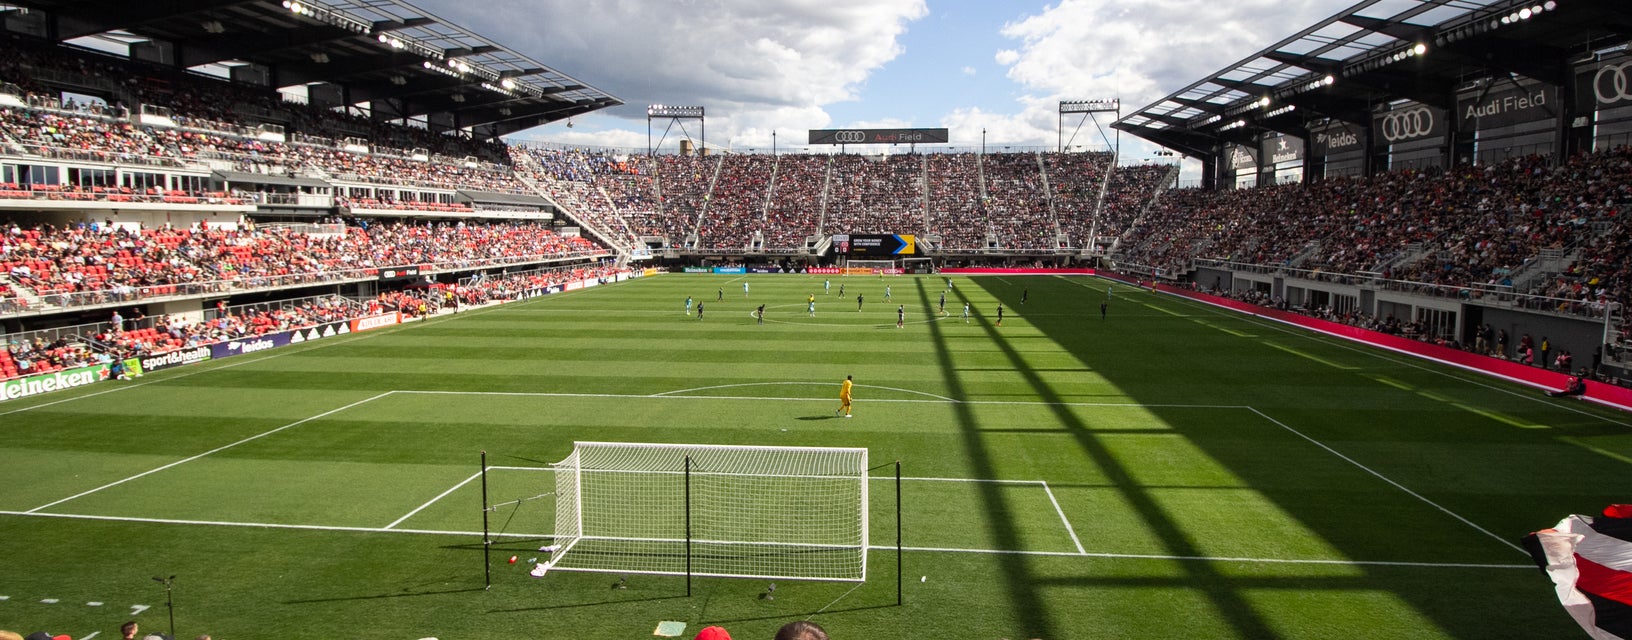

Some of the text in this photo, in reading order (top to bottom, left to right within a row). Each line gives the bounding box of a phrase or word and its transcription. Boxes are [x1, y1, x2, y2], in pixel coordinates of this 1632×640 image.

[1465, 90, 1545, 119] Audi Field
[875, 133, 922, 141] Audi Field
[1328, 132, 1357, 149] leidos
[242, 339, 274, 353] leidos
[142, 346, 211, 370] sport&health
